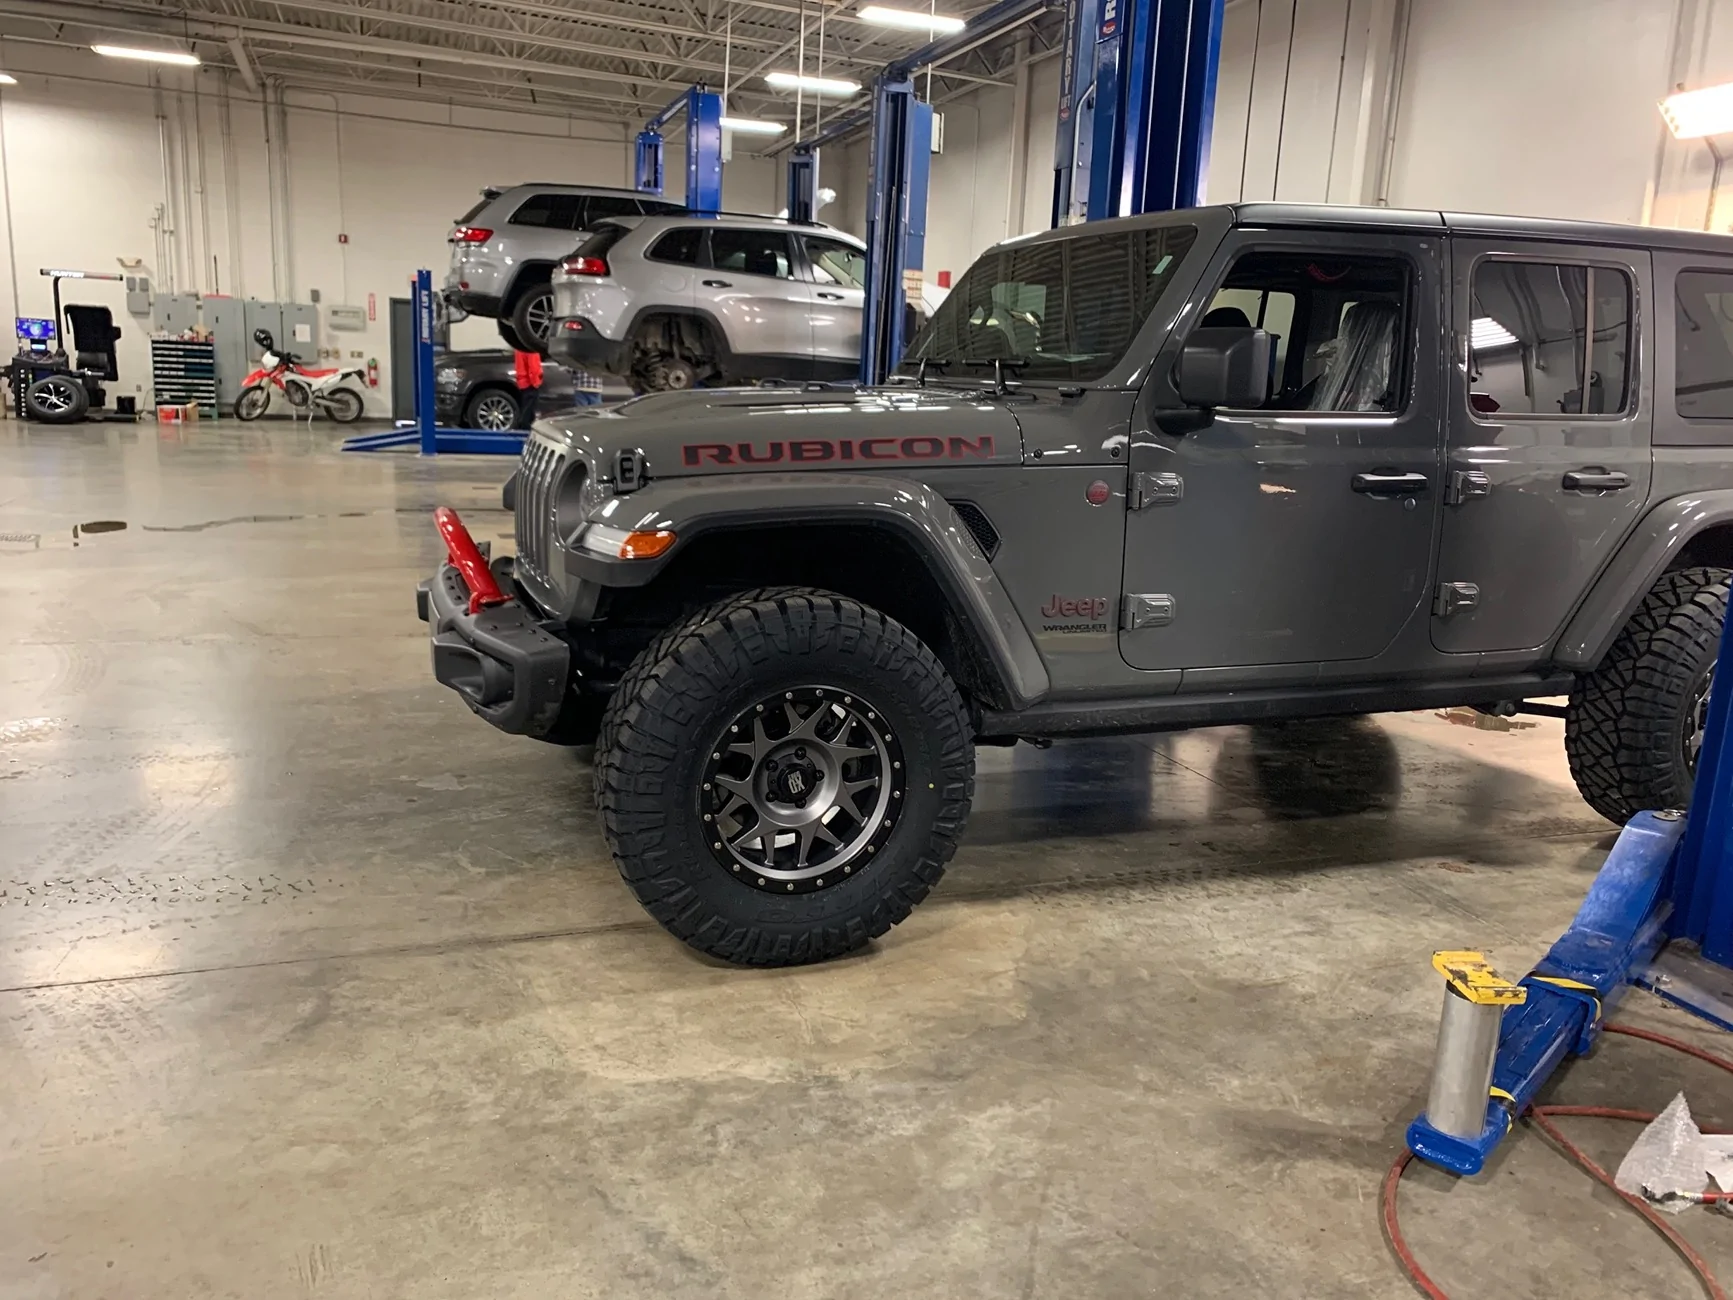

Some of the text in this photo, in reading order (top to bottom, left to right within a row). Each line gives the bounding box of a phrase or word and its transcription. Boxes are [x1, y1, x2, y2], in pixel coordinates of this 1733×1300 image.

[50, 270, 84, 278] HUNTER
[682, 436, 995, 467] RUBICON
[1040, 593, 1110, 621] Jeep
